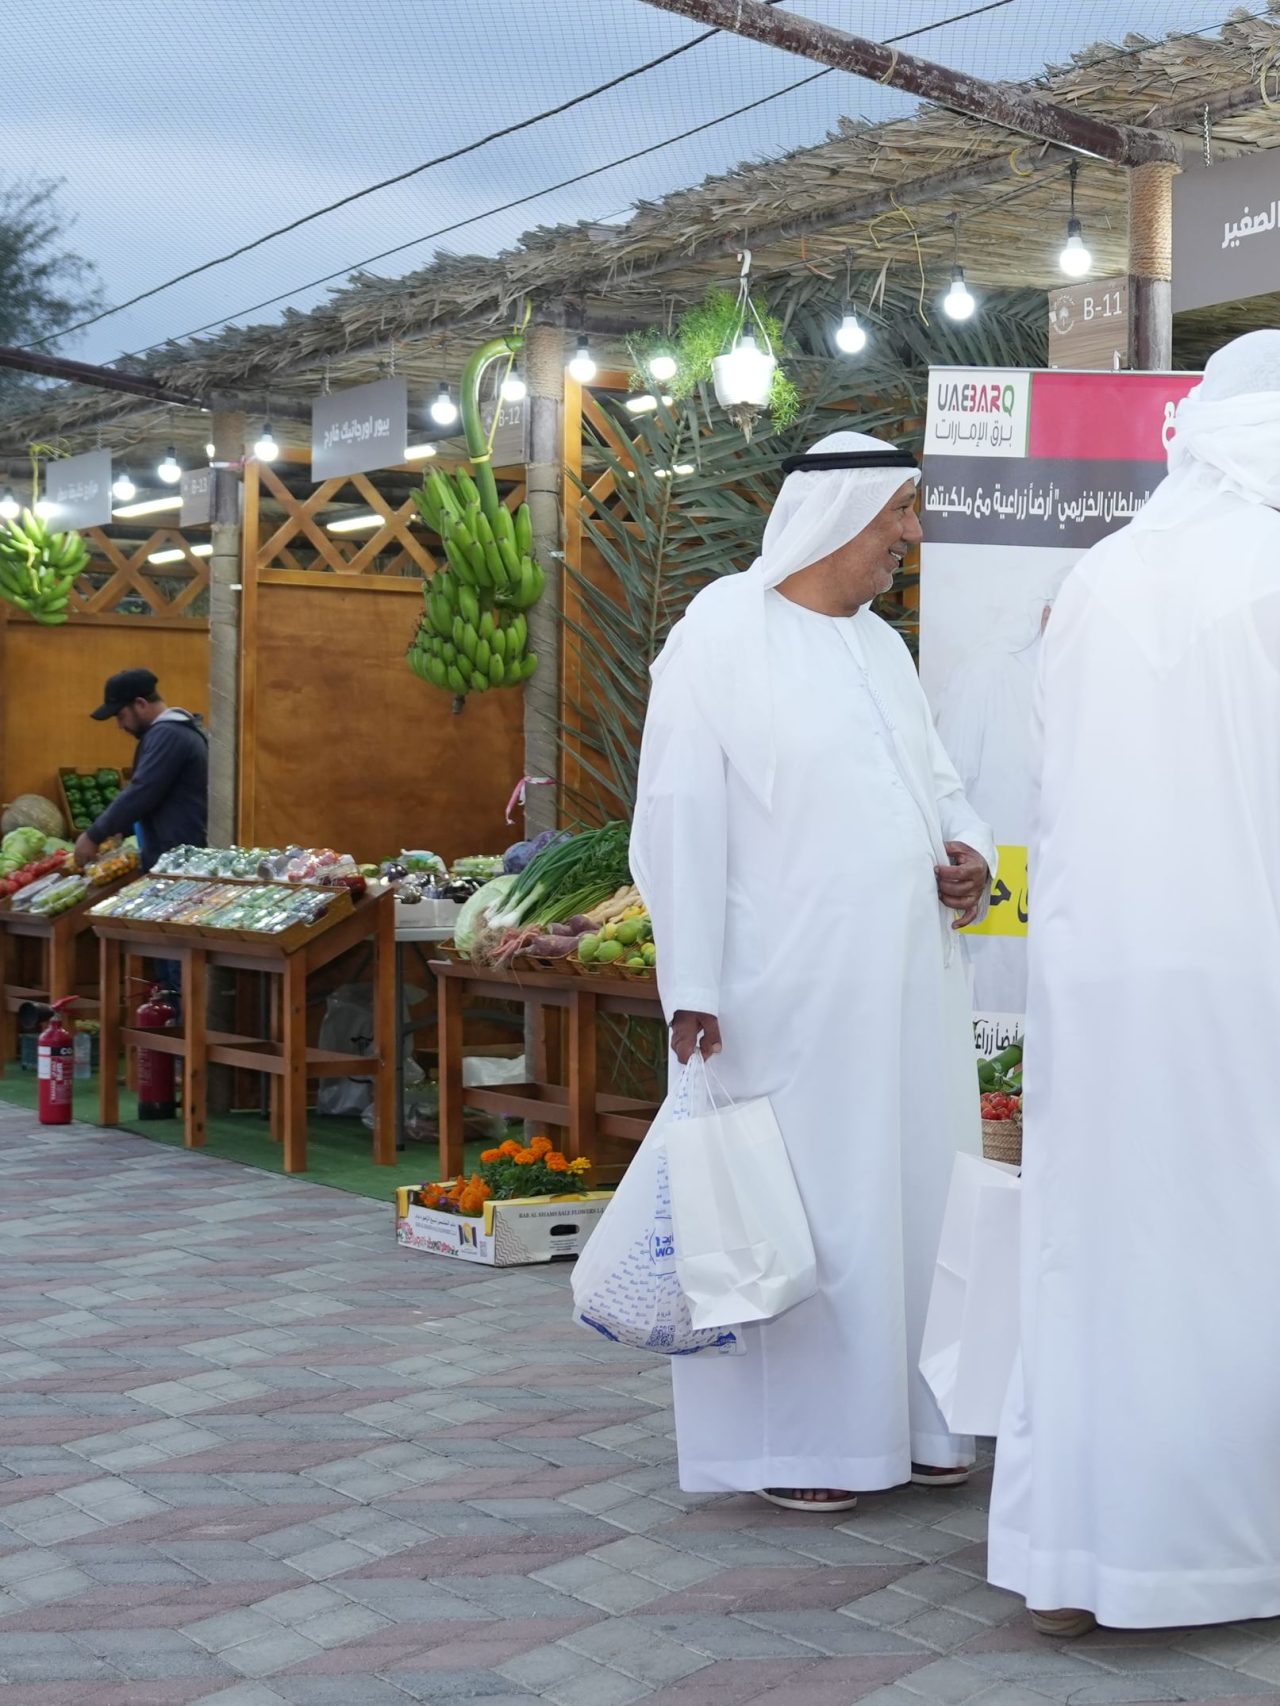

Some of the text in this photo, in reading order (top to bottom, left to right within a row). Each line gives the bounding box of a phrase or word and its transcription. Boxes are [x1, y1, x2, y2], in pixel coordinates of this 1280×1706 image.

[1083, 291, 1123, 321] B-11
[498, 405, 521, 427] B-12
[934, 418, 1014, 449] برق الإمارات
[924, 483, 973, 519] ملكيتها
[973, 485, 992, 520] مع
[992, 483, 1028, 520] زراعية
